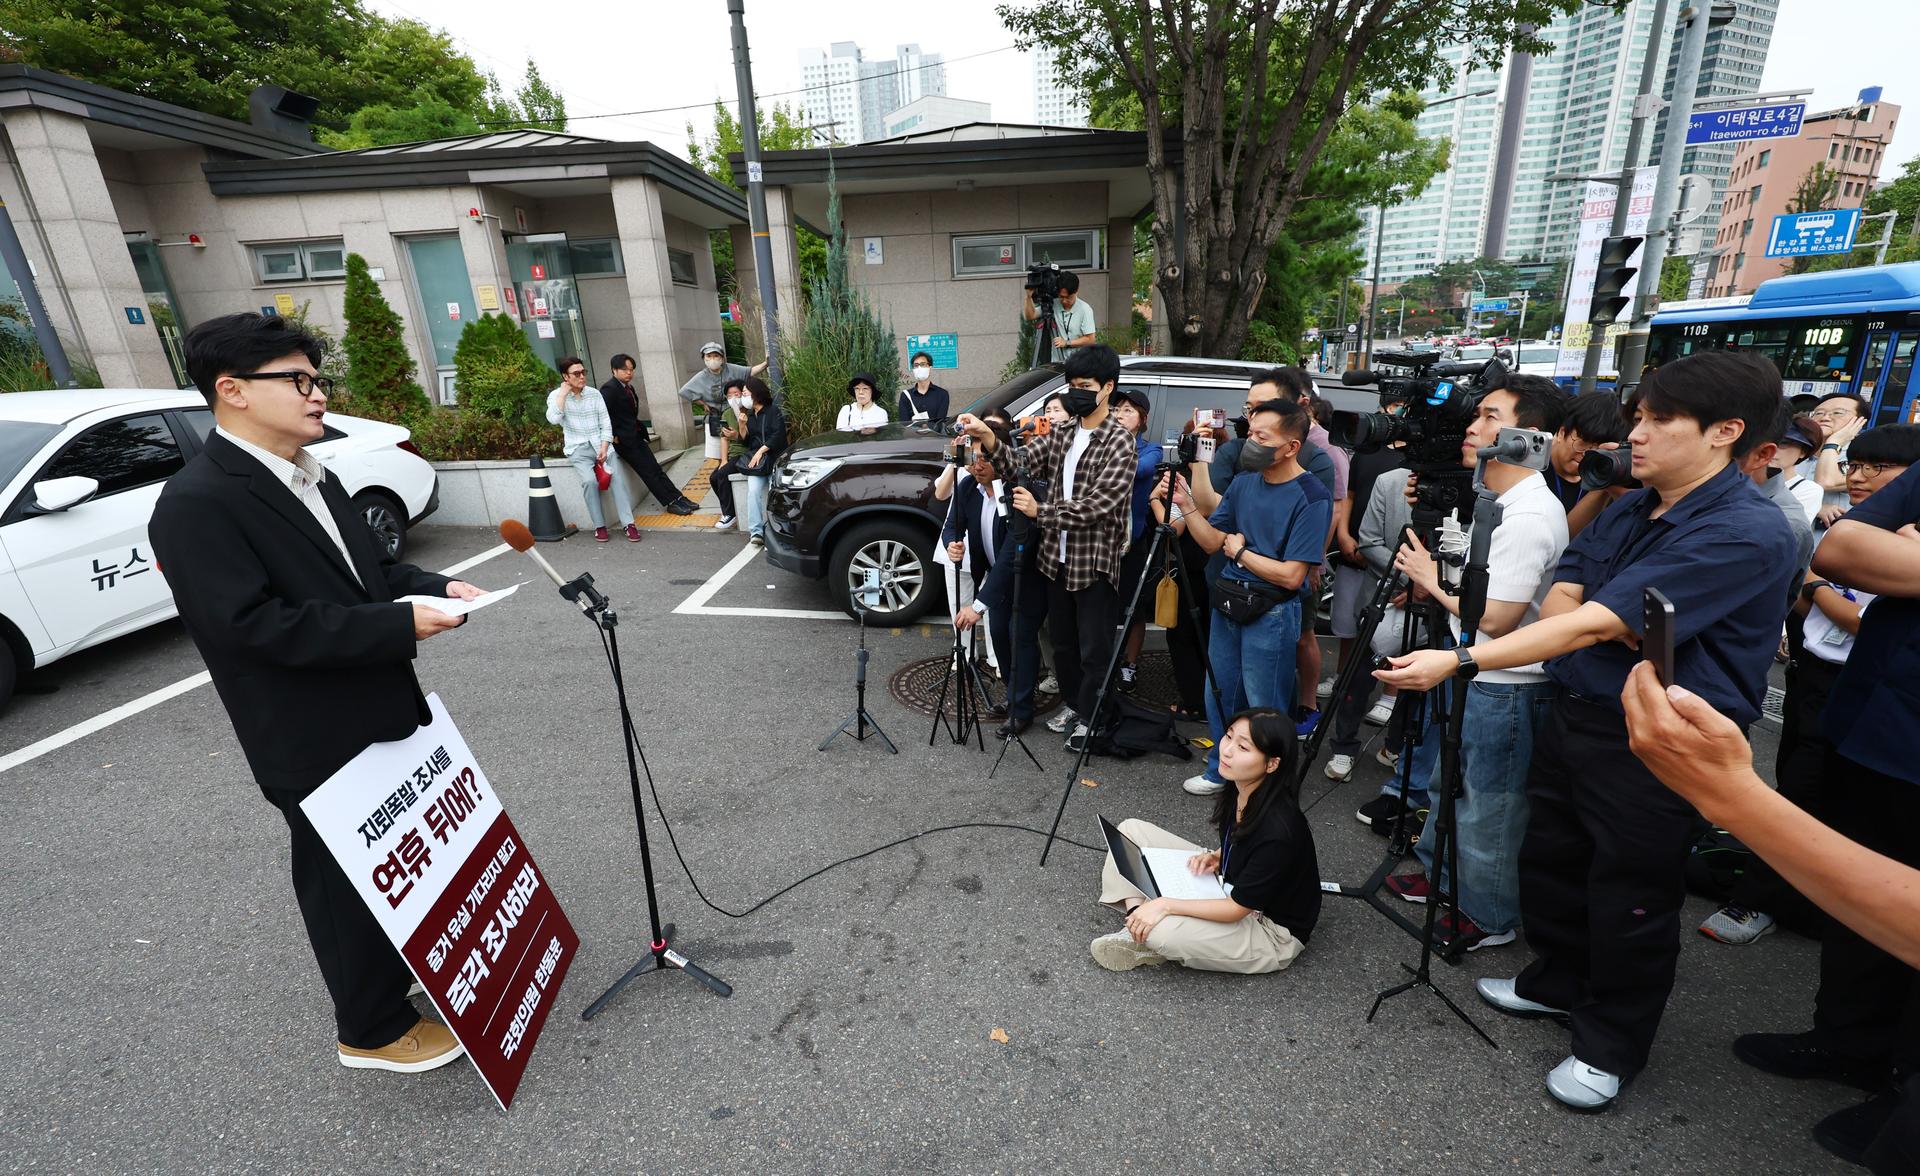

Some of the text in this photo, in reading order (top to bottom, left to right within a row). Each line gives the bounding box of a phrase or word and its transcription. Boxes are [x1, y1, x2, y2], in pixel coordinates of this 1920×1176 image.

[1710, 123, 1797, 140] Itaewon-ro 4-gil
[1717, 106, 1802, 127] 이태원로4길
[1683, 324, 1709, 337] 110B
[1804, 327, 1844, 346] 110B
[1868, 321, 1885, 330] 1173
[91, 547, 150, 592] 뉴스
[356, 744, 453, 850] 지뢰폭발 조사를
[370, 765, 484, 910] 연휴 뒤에?
[425, 835, 518, 975] 증거 유실 기다리지 말고
[445, 861, 540, 1018] 즉각 조사하라
[499, 934, 565, 1061] 국회의원 한동훈
